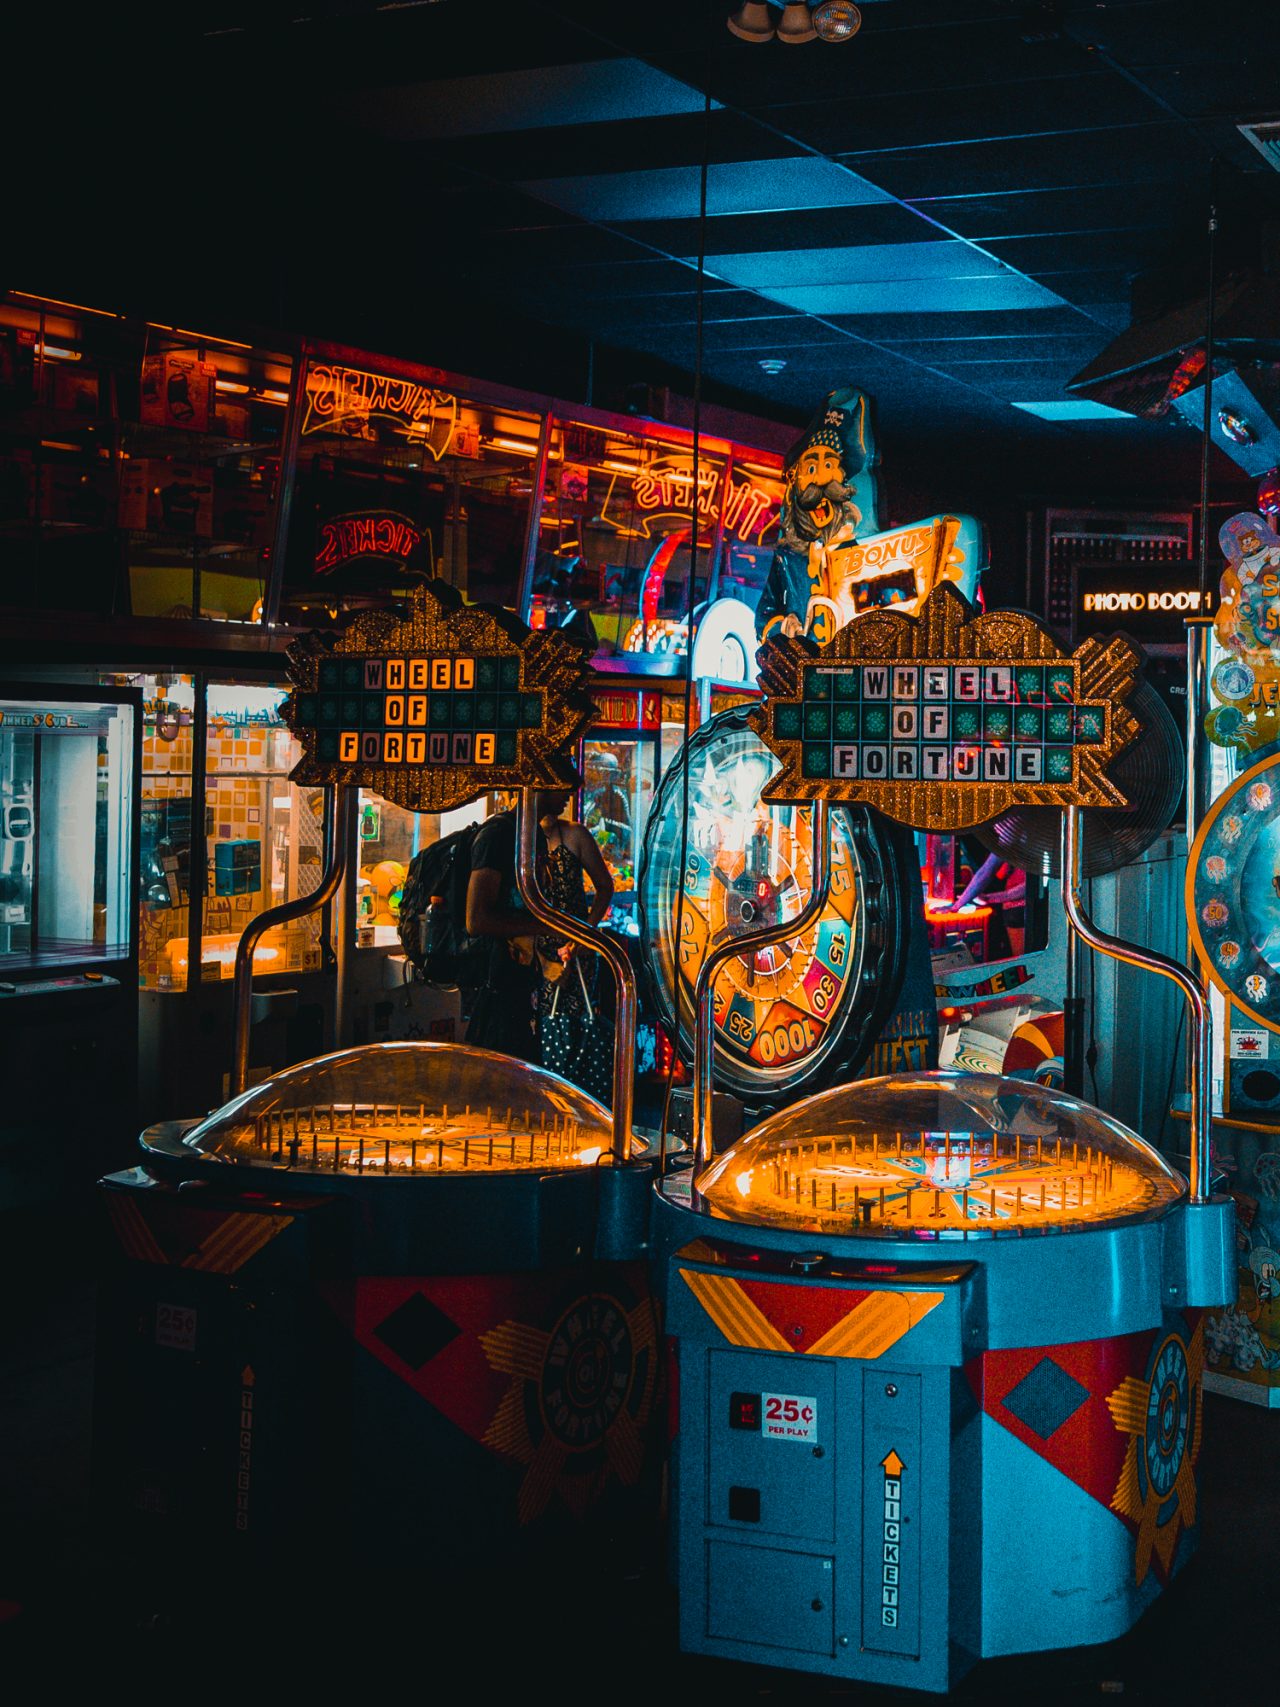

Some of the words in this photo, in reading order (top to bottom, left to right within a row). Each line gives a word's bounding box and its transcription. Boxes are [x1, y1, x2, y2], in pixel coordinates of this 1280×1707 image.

[844, 530, 934, 576] BONUS
[1083, 592, 1145, 612] PHOTO
[367, 664, 471, 686] WHEEL
[867, 671, 1006, 697] WHEEL
[389, 700, 423, 721] OF
[897, 711, 944, 735] OF
[344, 737, 491, 760] FORTUNE
[840, 750, 1037, 777] FORTUNE
[304, 953, 318, 966] $1
[828, 931, 847, 965] 15
[812, 974, 837, 1013] 30
[729, 1010, 754, 1041] 25
[759, 1019, 815, 1063] 1000
[158, 1307, 195, 1333] 25¢
[765, 1397, 814, 1424] 25¢
[768, 1425, 785, 1435] PER
[786, 1427, 809, 1437] PLAY
[237, 1391, 253, 1529] TICKETS
[883, 1481, 899, 1625] TICKETS
